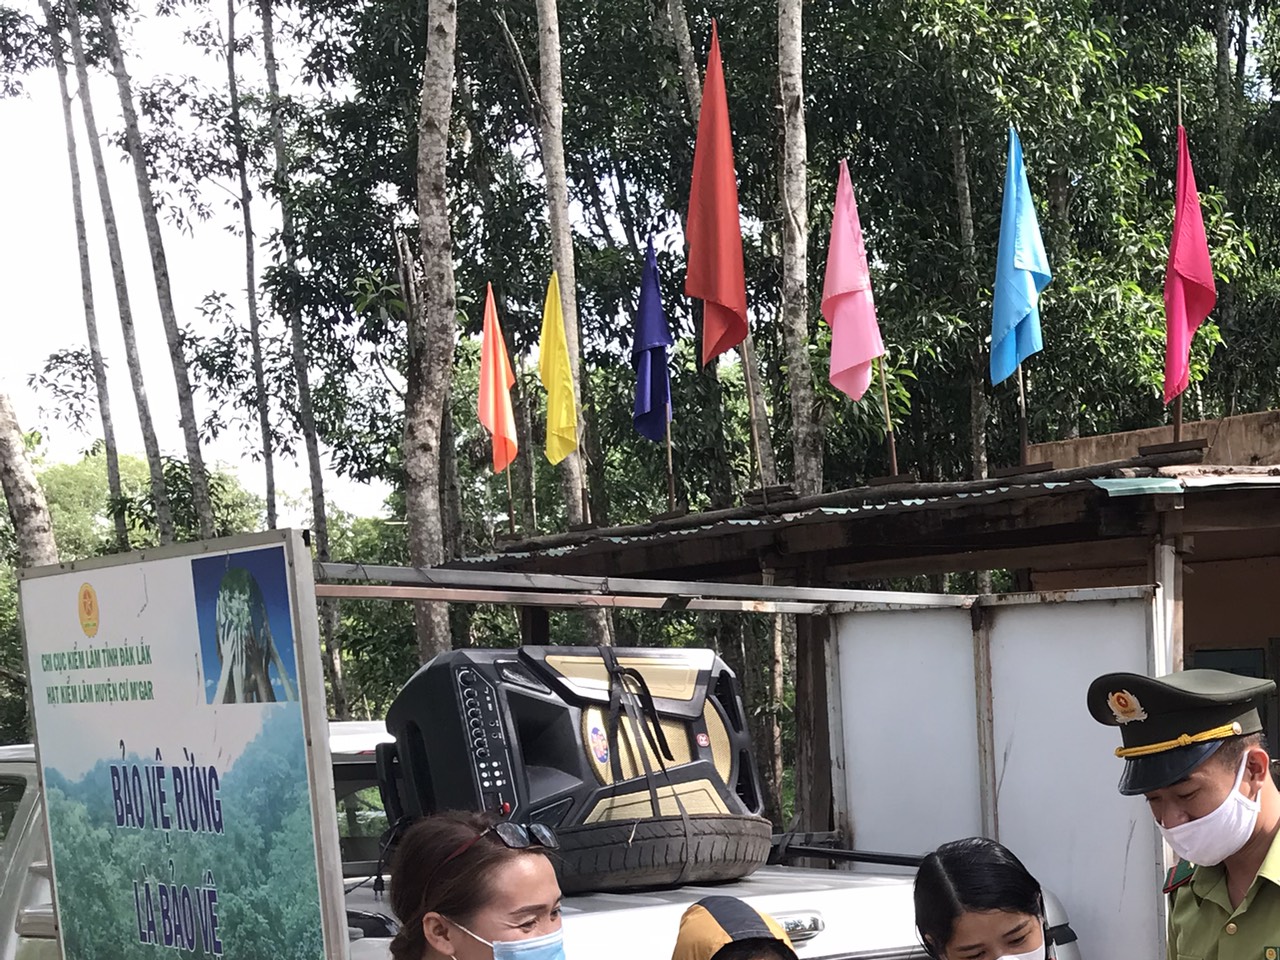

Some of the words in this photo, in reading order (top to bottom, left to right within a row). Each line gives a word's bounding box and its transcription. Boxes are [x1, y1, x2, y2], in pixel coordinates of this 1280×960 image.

[41, 654, 53, 672] CHI
[54, 652, 68, 675] CỤC
[86, 644, 102, 669] LÂM
[46, 686, 60, 708] HẠT
[78, 680, 94, 703] LÂM
[110, 739, 146, 830] BẢO
[146, 747, 171, 845] VỆ
[172, 747, 225, 836] RỪNG
[133, 862, 159, 946] LÀ
[158, 859, 196, 952] BẢO
